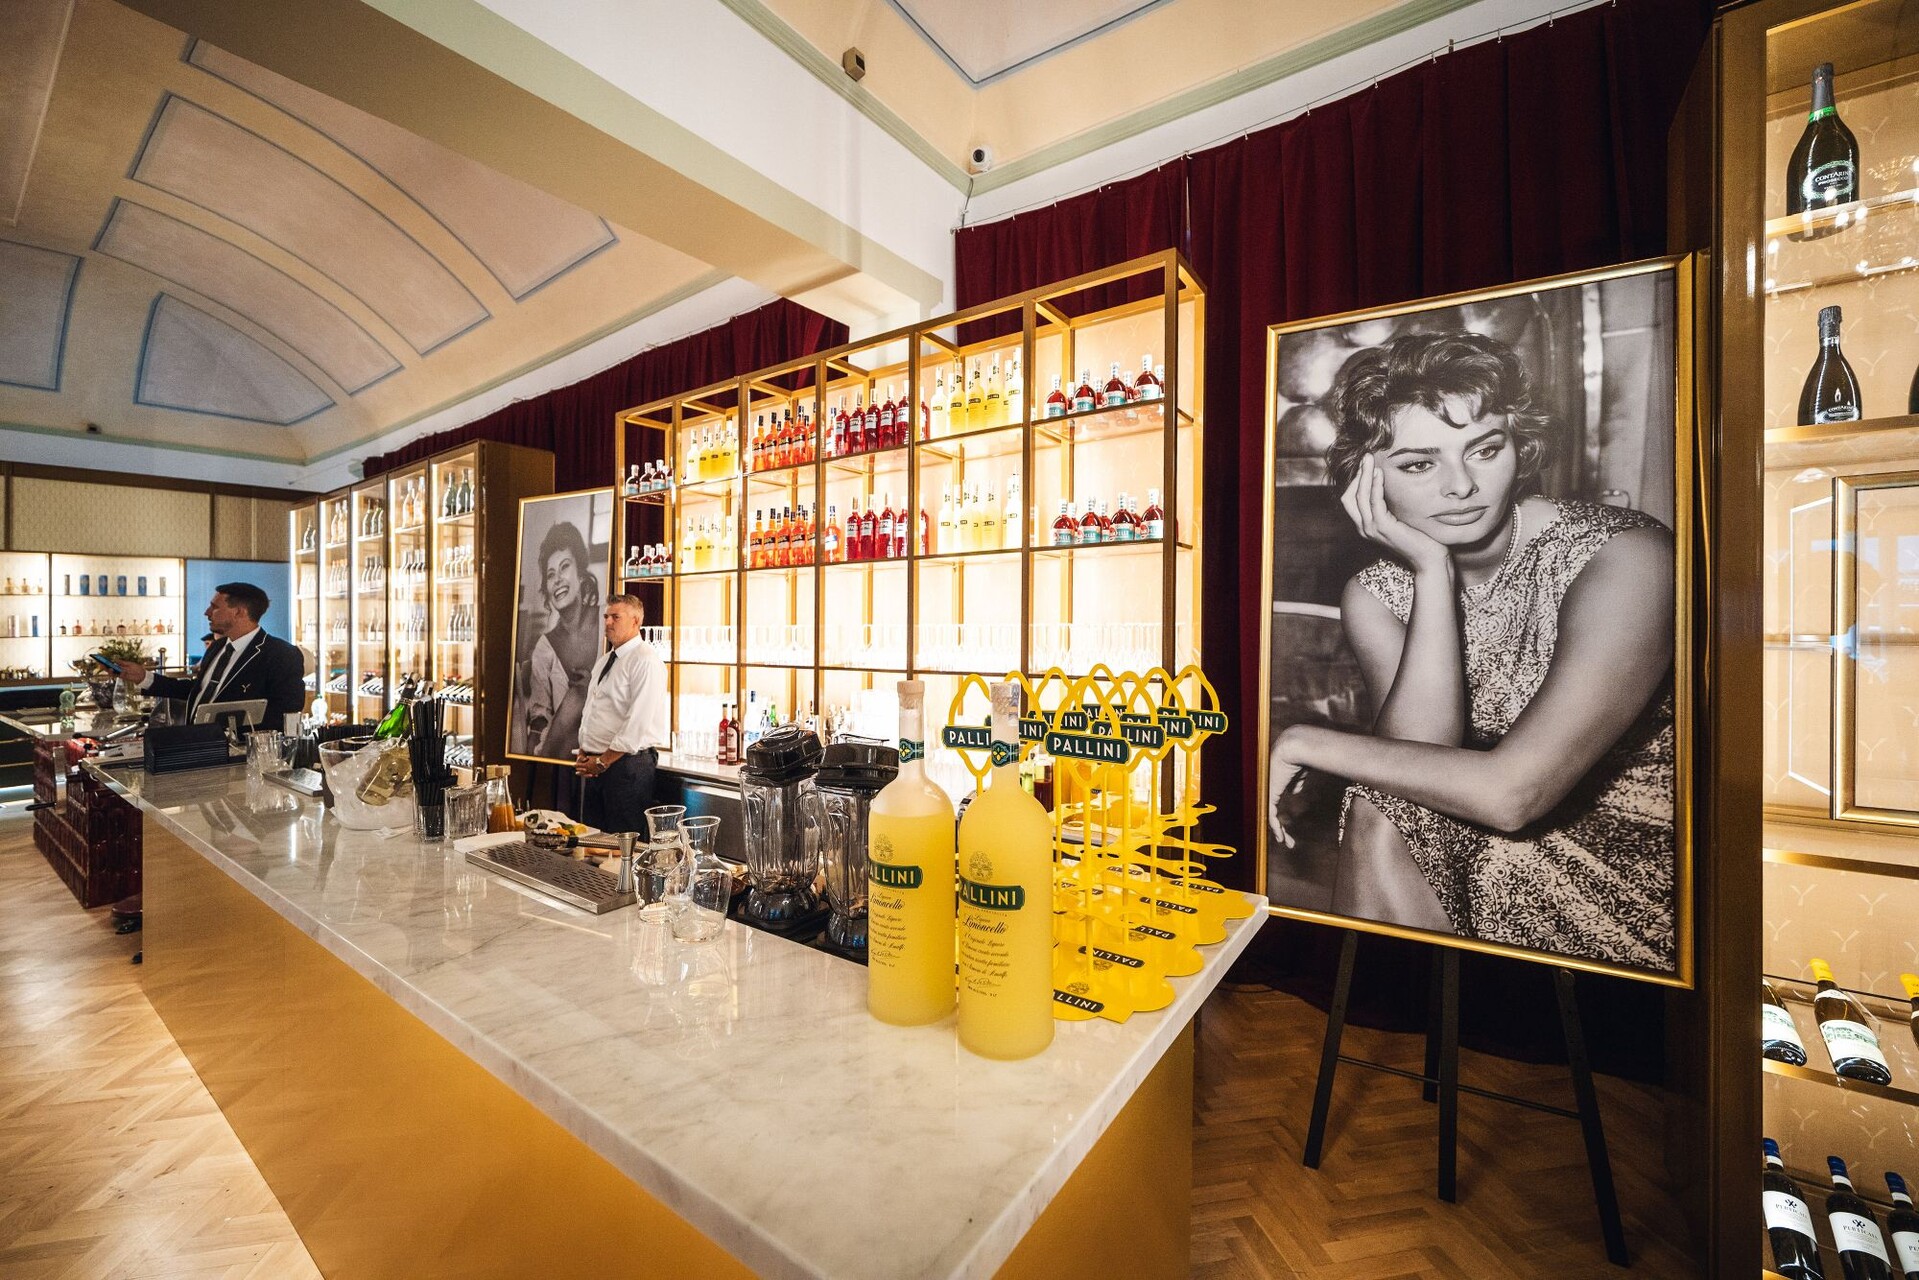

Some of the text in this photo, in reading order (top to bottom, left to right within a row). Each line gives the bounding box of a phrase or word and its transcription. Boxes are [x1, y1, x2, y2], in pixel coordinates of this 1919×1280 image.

[949, 730, 991, 746] PALLI
[1098, 725, 1157, 744] PALINI
[1053, 737, 1121, 759] PALLINI
[868, 864, 914, 884] ALLINI
[960, 880, 1016, 906] ALLINI
[1140, 926, 1171, 938] PALL
[1093, 950, 1138, 966] PALLIN
[1053, 991, 1098, 1010] LLINI
